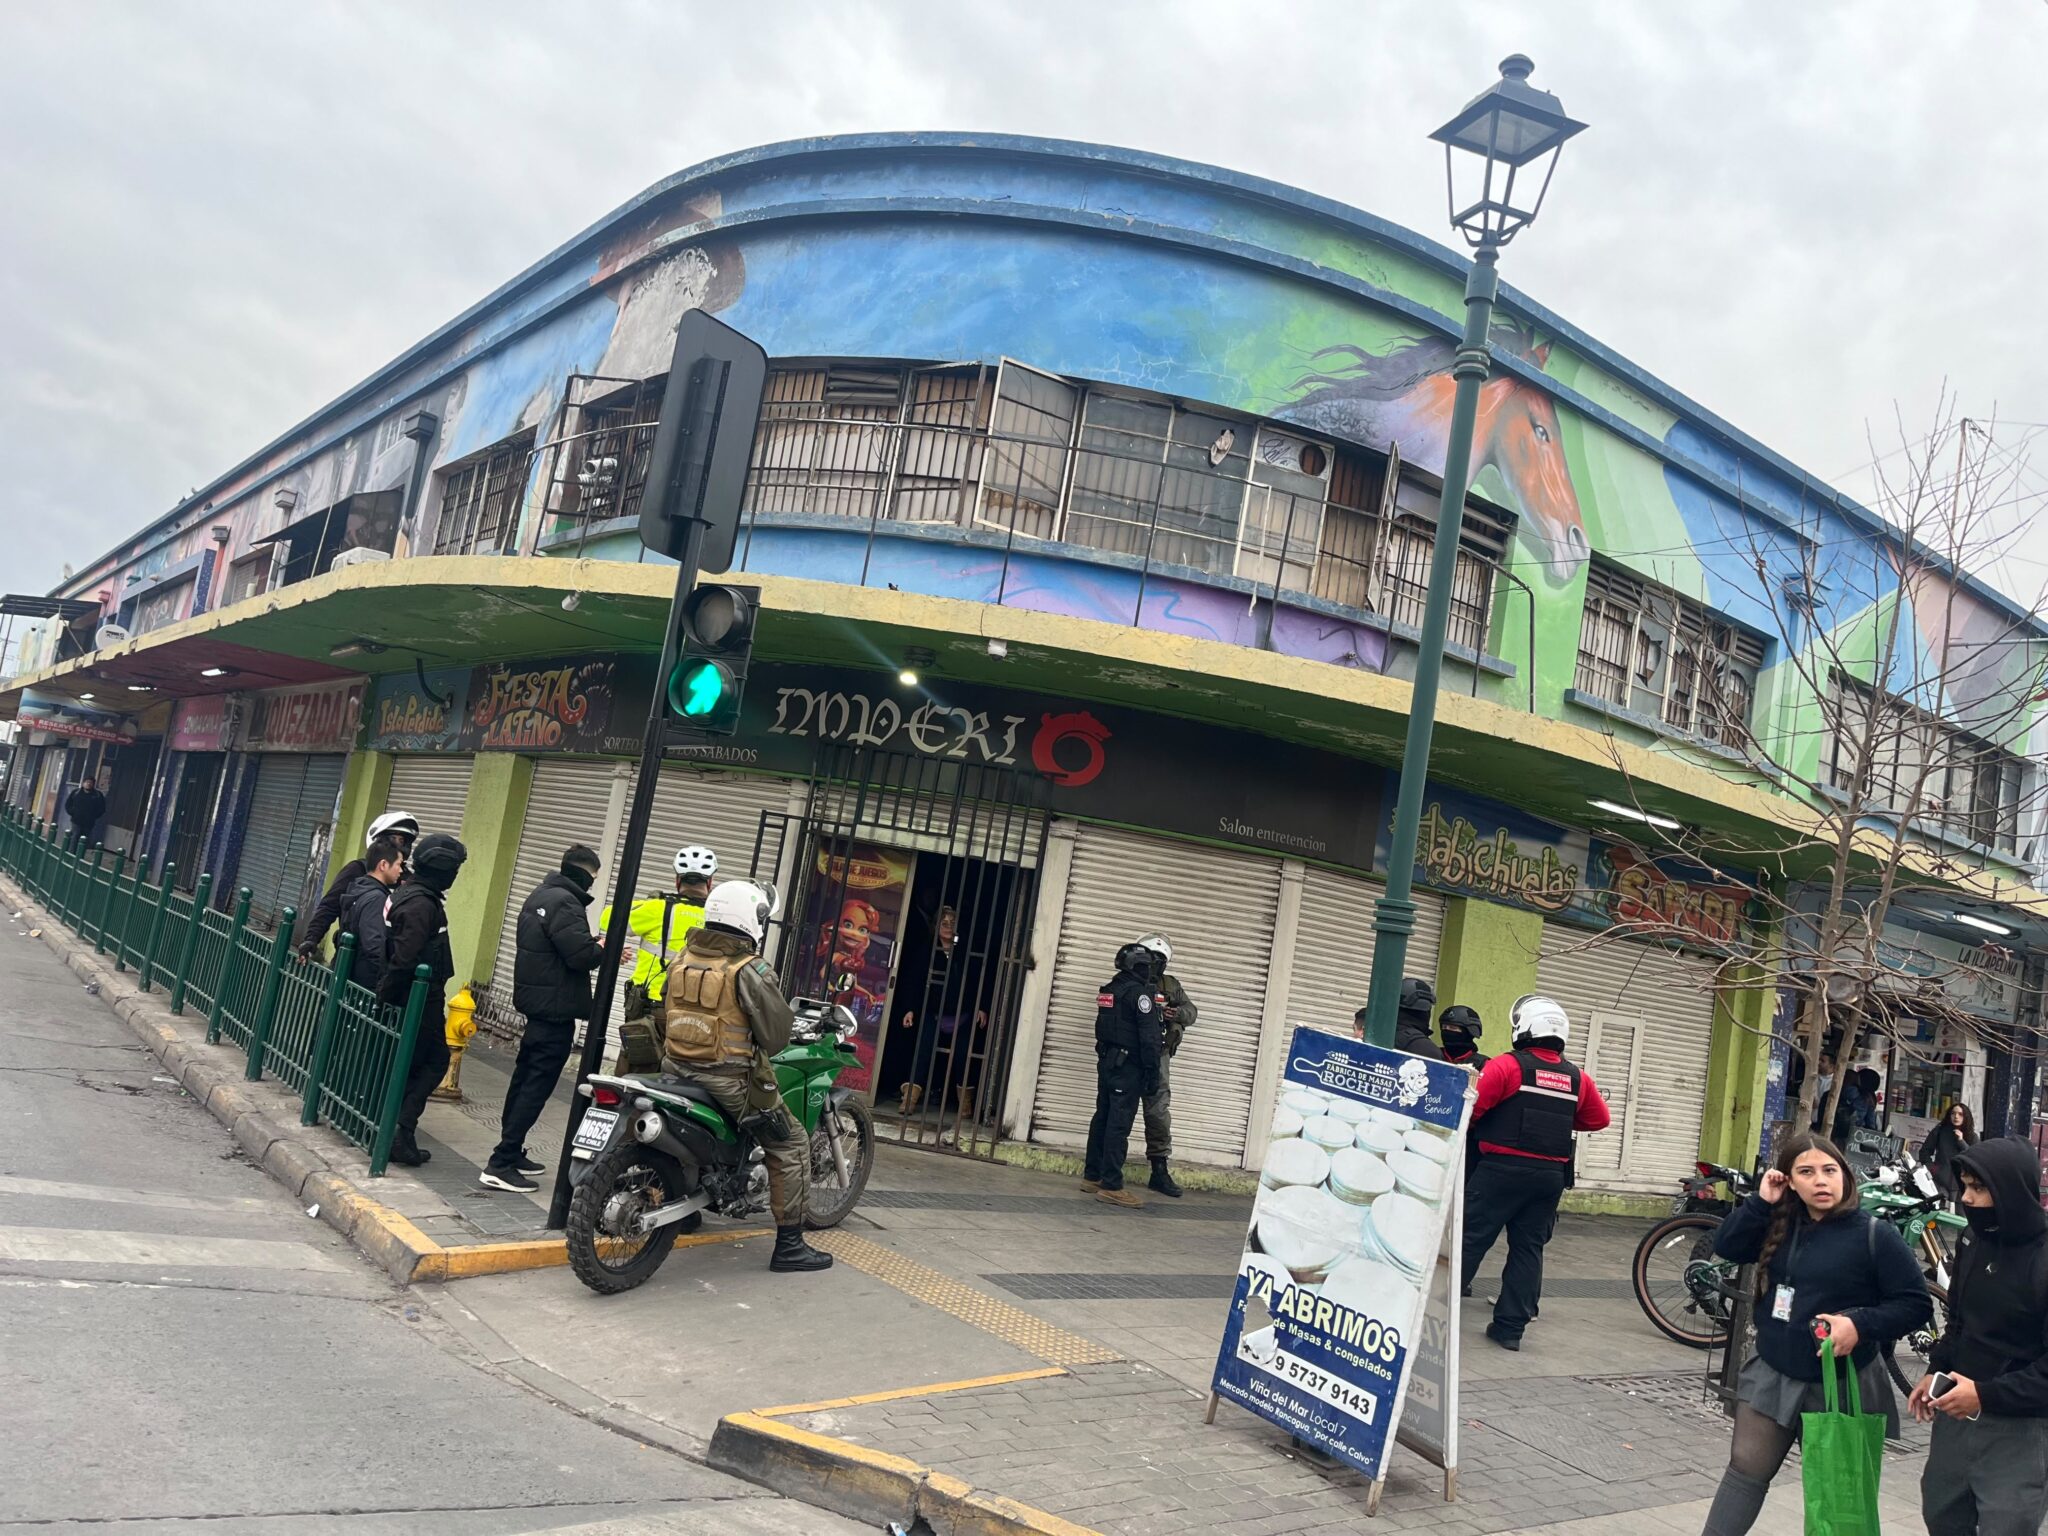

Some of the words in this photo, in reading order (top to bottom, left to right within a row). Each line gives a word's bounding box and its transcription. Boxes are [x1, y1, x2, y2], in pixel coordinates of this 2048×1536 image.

[38, 719, 74, 731] RESERVE
[379, 699, 401, 736] Isla
[602, 736, 640, 750] SORTEO
[1218, 816, 1253, 840] Salon
[1256, 826, 1327, 853] entretencion
[1957, 947, 1971, 964] LA
[1322, 1070, 1393, 1101] ROCHET
[1357, 1072, 1367, 1081] DE
[1368, 1074, 1393, 1088] MASAS
[1537, 1071, 1571, 1082] INSPECTOR
[1538, 1080, 1570, 1090] MUNICIPAL
[1424, 1093, 1442, 1104] Food
[1247, 1267, 1274, 1308] YA
[1277, 1285, 1400, 1363] ABRIMOS
[1273, 1317, 1286, 1330] de
[1288, 1322, 1321, 1347] Masas
[1324, 1340, 1332, 1351] &
[1335, 1346, 1393, 1381] congelados
[1274, 1355, 1285, 1371] 9
[1288, 1363, 1328, 1392] 5737
[1330, 1383, 1370, 1415] 9143
[1219, 1378, 1249, 1399] Mercado
[1249, 1393, 1274, 1413] modelo
[1274, 1407, 1311, 1435] Rancagua,
[1313, 1427, 1329, 1445] "por
[1328, 1436, 1348, 1453] calle
[1348, 1447, 1374, 1465] Calvo"
[1250, 1378, 1270, 1398] Viña
[1272, 1391, 1288, 1406] del
[1289, 1400, 1309, 1418] Mar
[1309, 1408, 1338, 1435] Local
[1338, 1425, 1347, 1437] 7
